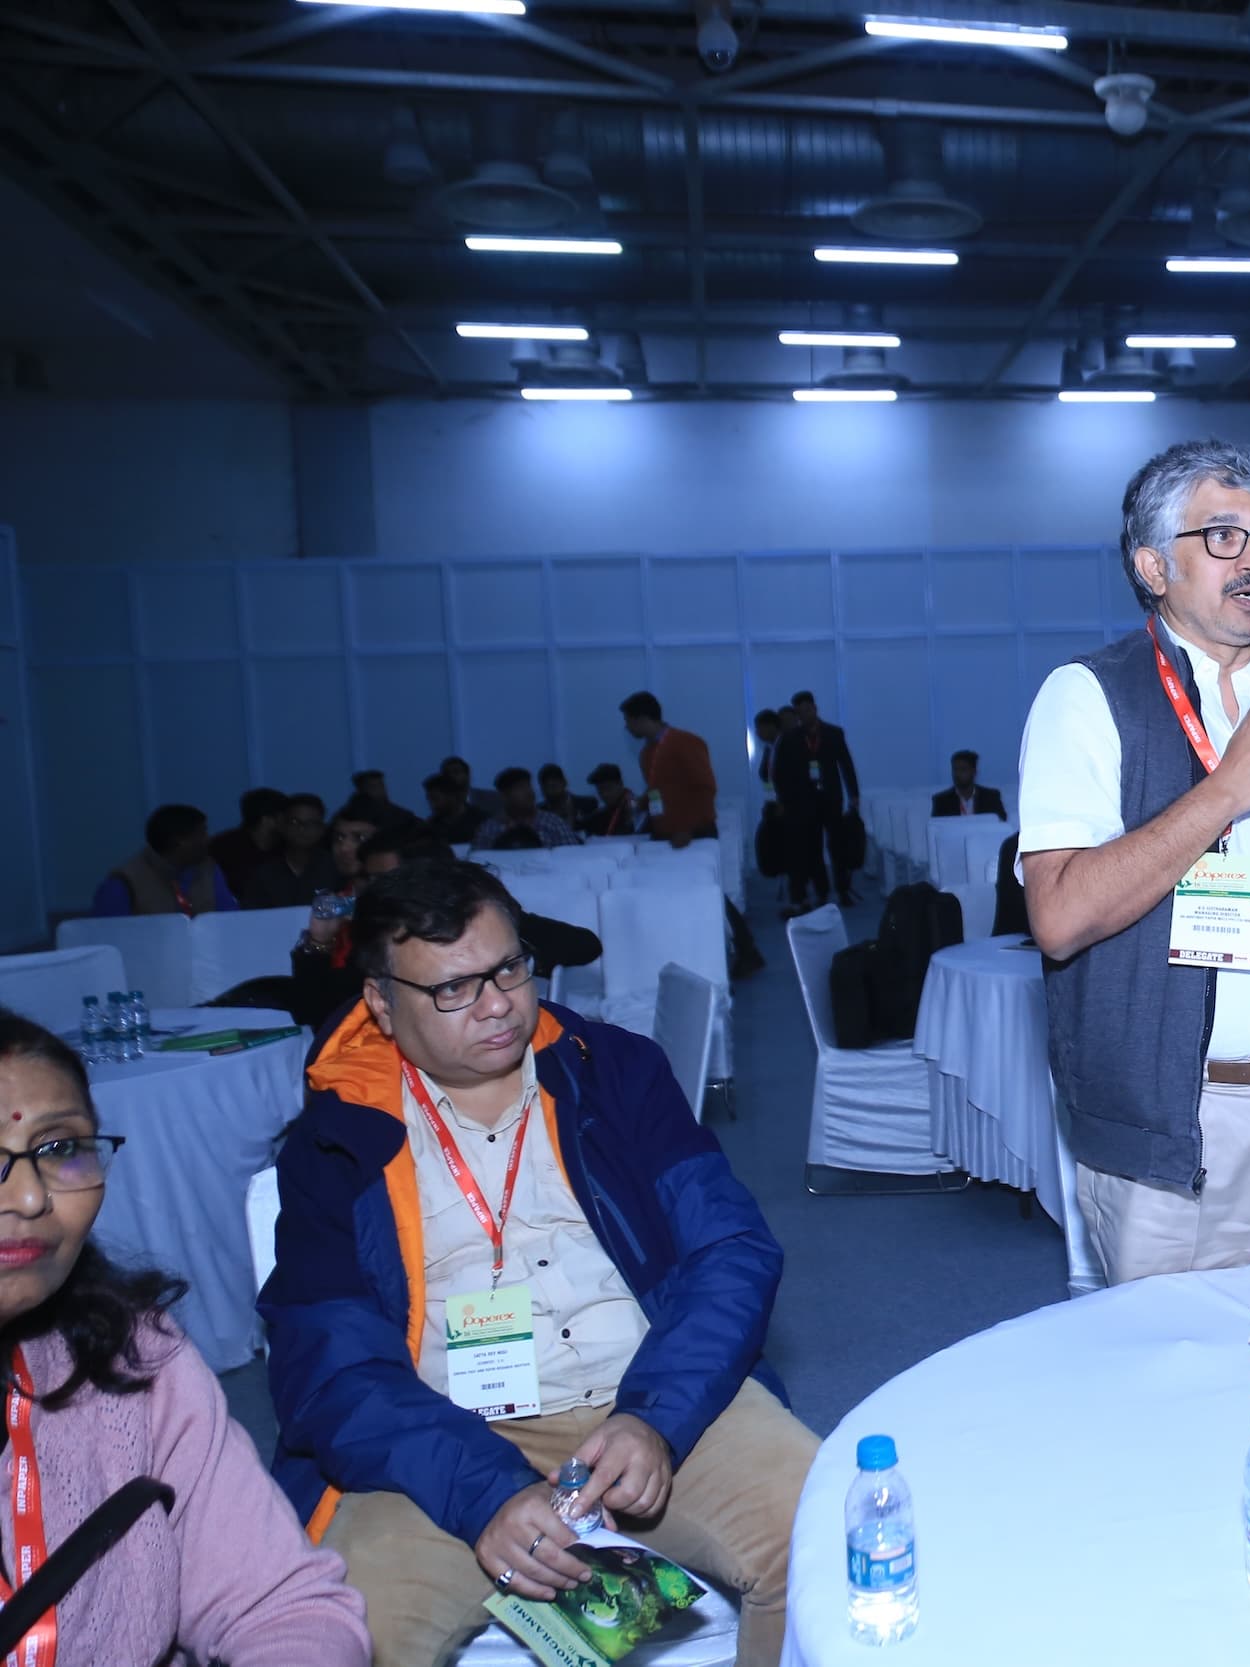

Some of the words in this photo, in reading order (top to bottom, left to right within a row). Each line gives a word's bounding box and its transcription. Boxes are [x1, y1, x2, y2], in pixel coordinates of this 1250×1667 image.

[1179, 949, 1225, 962] DELEGATE
[443, 1147, 461, 1177] INPAPER
[466, 1192, 488, 1224] INPAPER
[16, 1455, 28, 1516] INPAPER
